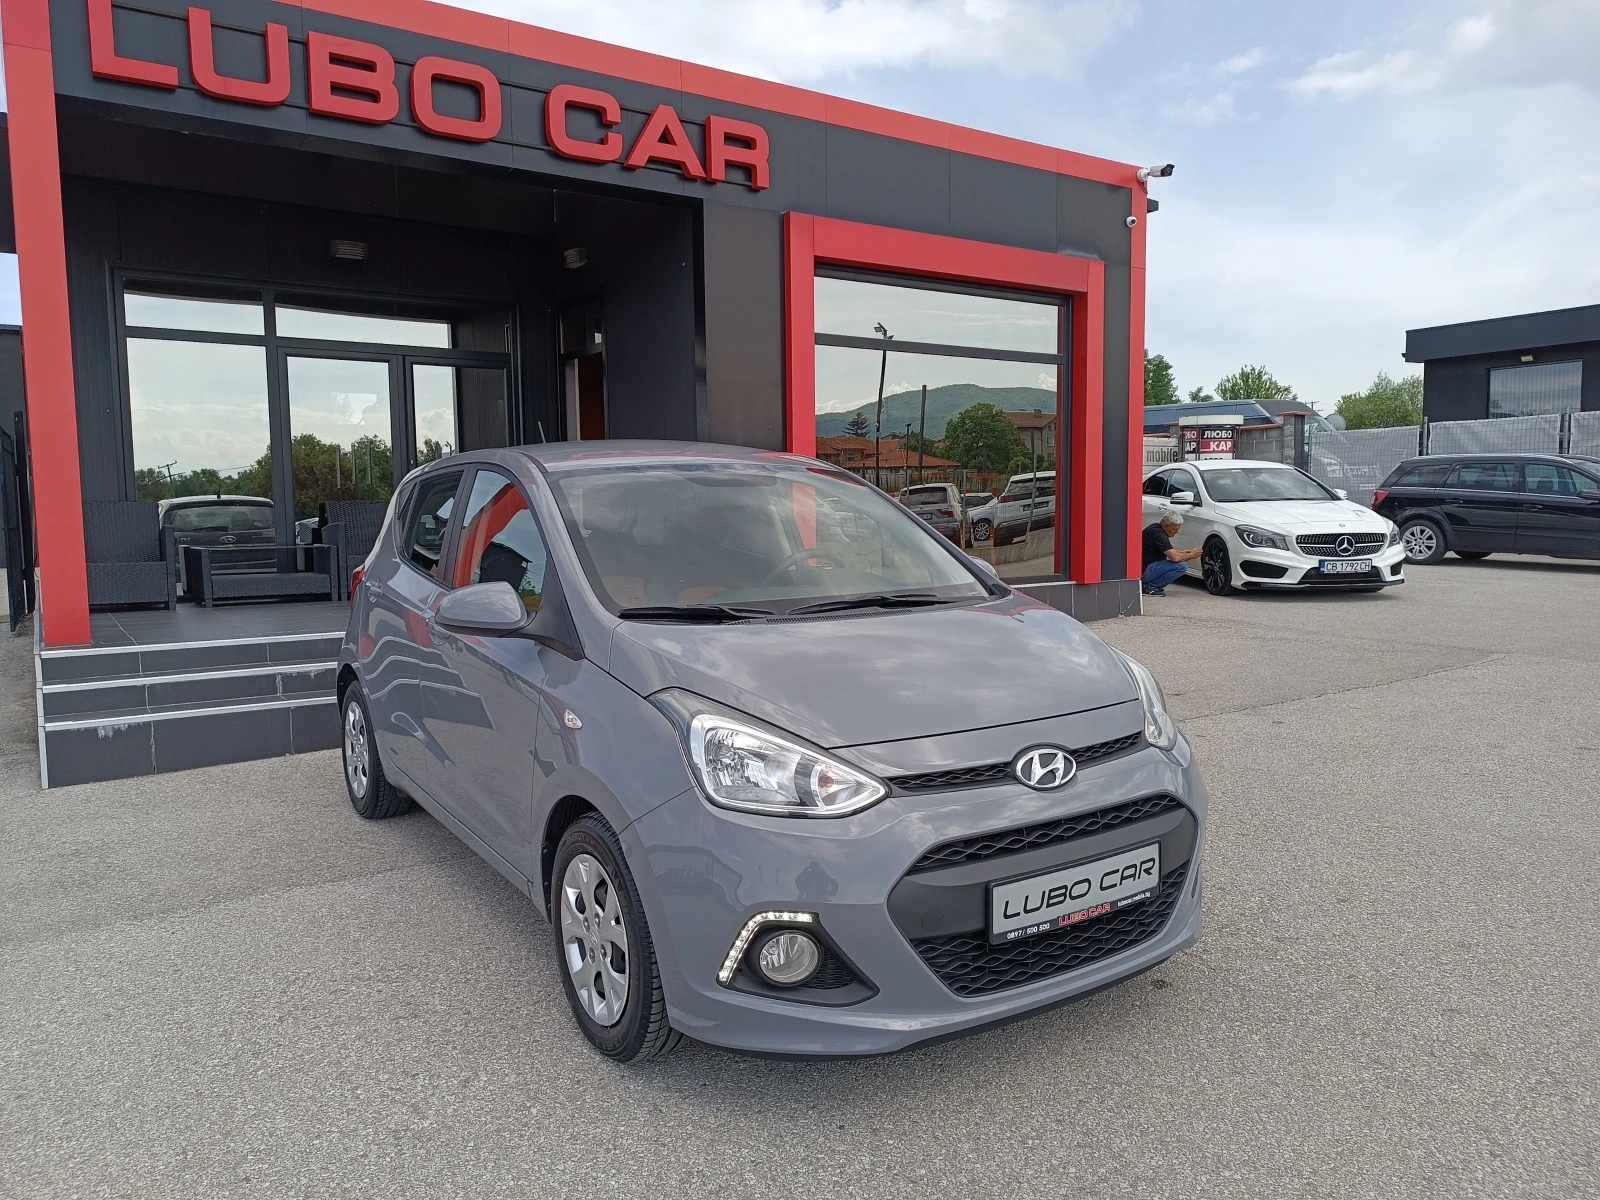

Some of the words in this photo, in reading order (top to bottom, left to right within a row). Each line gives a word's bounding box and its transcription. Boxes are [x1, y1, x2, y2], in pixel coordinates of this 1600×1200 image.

[87, 0, 502, 142] LUBO
[544, 83, 770, 191] CAR
[1203, 430, 1232, 438] ЛЮБО
[1209, 441, 1232, 451] КАР
[1146, 448, 1178, 462] mobile
[1326, 562, 1338, 571] CB
[1340, 562, 1359, 571] 1792
[1360, 561, 1371, 570] CH
[1003, 878, 1092, 920] LUBO
[1099, 857, 1156, 891] CAR
[1058, 909, 1088, 928] LUBO
[1088, 902, 1111, 917] CAR
[1026, 926, 1038, 935] 500
[1039, 922, 1050, 931] 500
